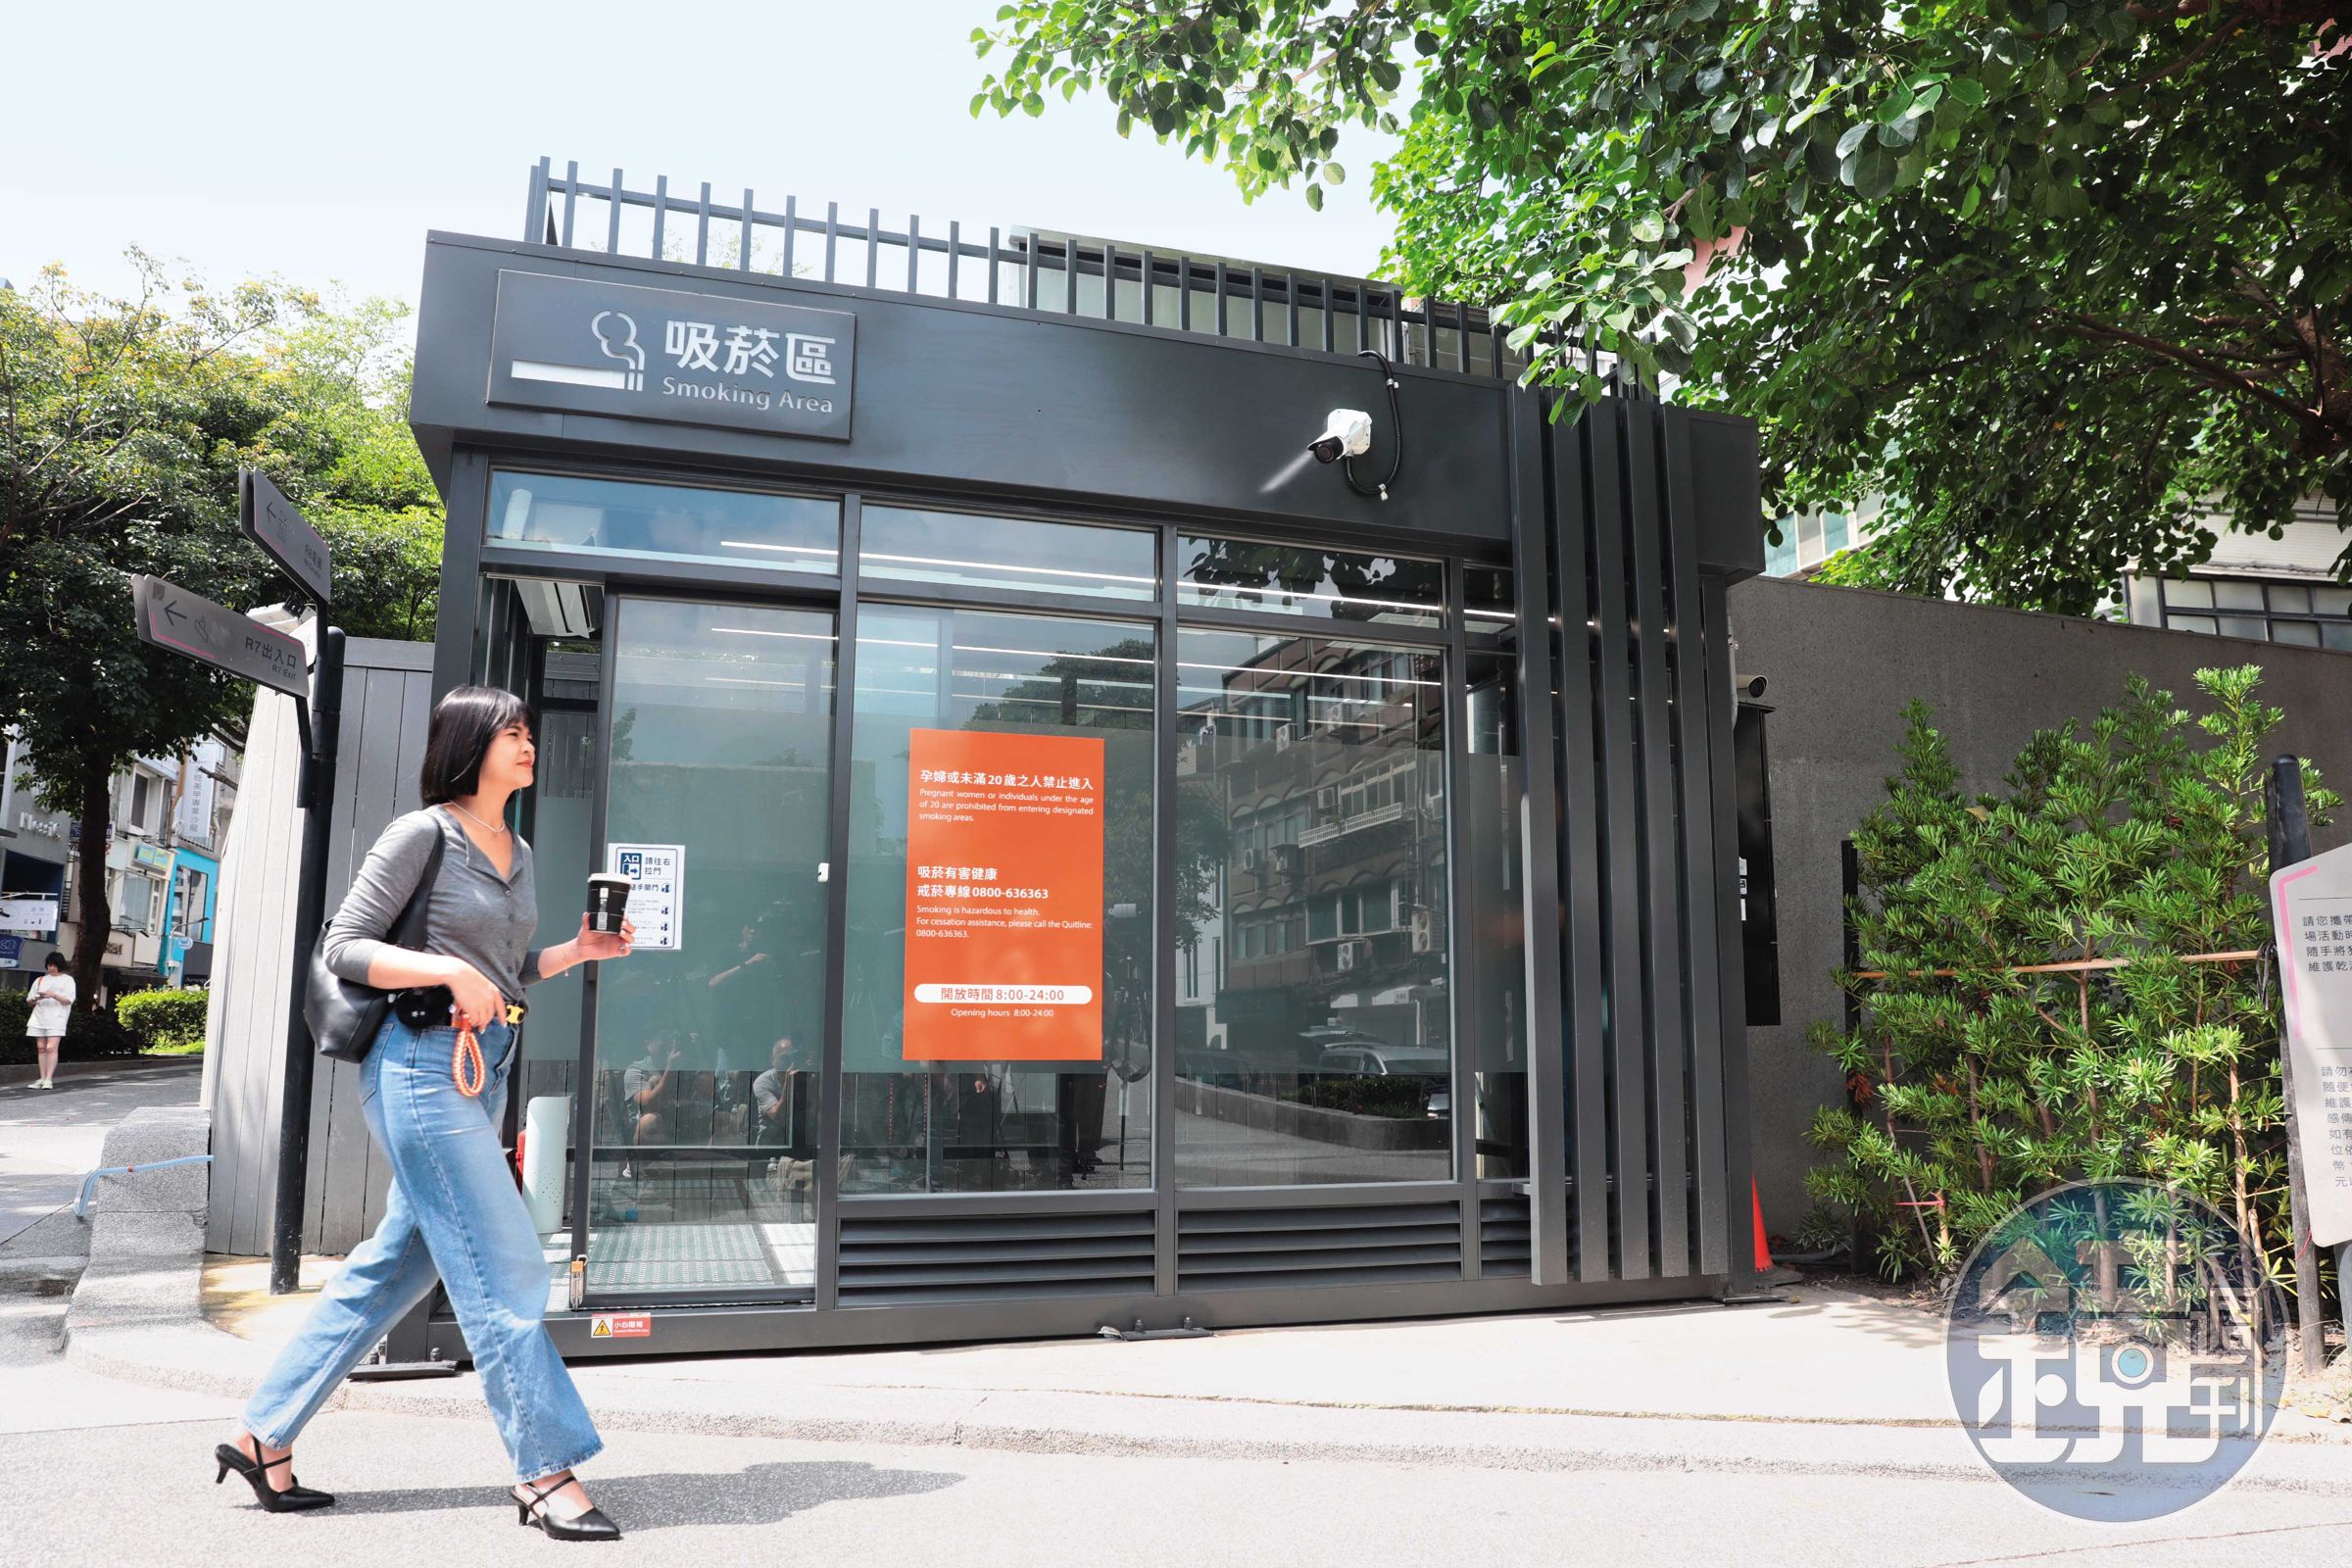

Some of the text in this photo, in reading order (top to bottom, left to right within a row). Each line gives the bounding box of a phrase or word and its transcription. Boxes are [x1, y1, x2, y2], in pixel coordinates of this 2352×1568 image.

[665, 319, 836, 384] 吸菸區
[662, 376, 832, 414] Smoking Area
[245, 636, 297, 668] R7出入口
[272, 664, 296, 680] R7 Exit
[919, 788, 954, 799] Pregnant
[999, 792, 1039, 801] individuals
[1041, 794, 1062, 803] under
[956, 802, 996, 811] prohibited
[1018, 805, 1051, 814] entering
[1053, 806, 1094, 815] designated
[919, 812, 952, 822] smoking
[623, 855, 640, 863] 入口
[917, 866, 998, 881] 吸菸有害健康
[916, 906, 952, 915] Smoking
[961, 906, 1002, 915] hazardous
[1013, 907, 1041, 916] health.
[967, 919, 1006, 928] assistance,
[1008, 919, 1032, 929] please
[1061, 920, 1094, 929] Quitline:
[916, 929, 969, 938] 0800-636363.
[2308, 960, 2352, 972] 維護乾
[951, 1008, 986, 1018] Opening
[2321, 1066, 2352, 1077] 請勿
[2323, 1081, 2352, 1093] 隨便
